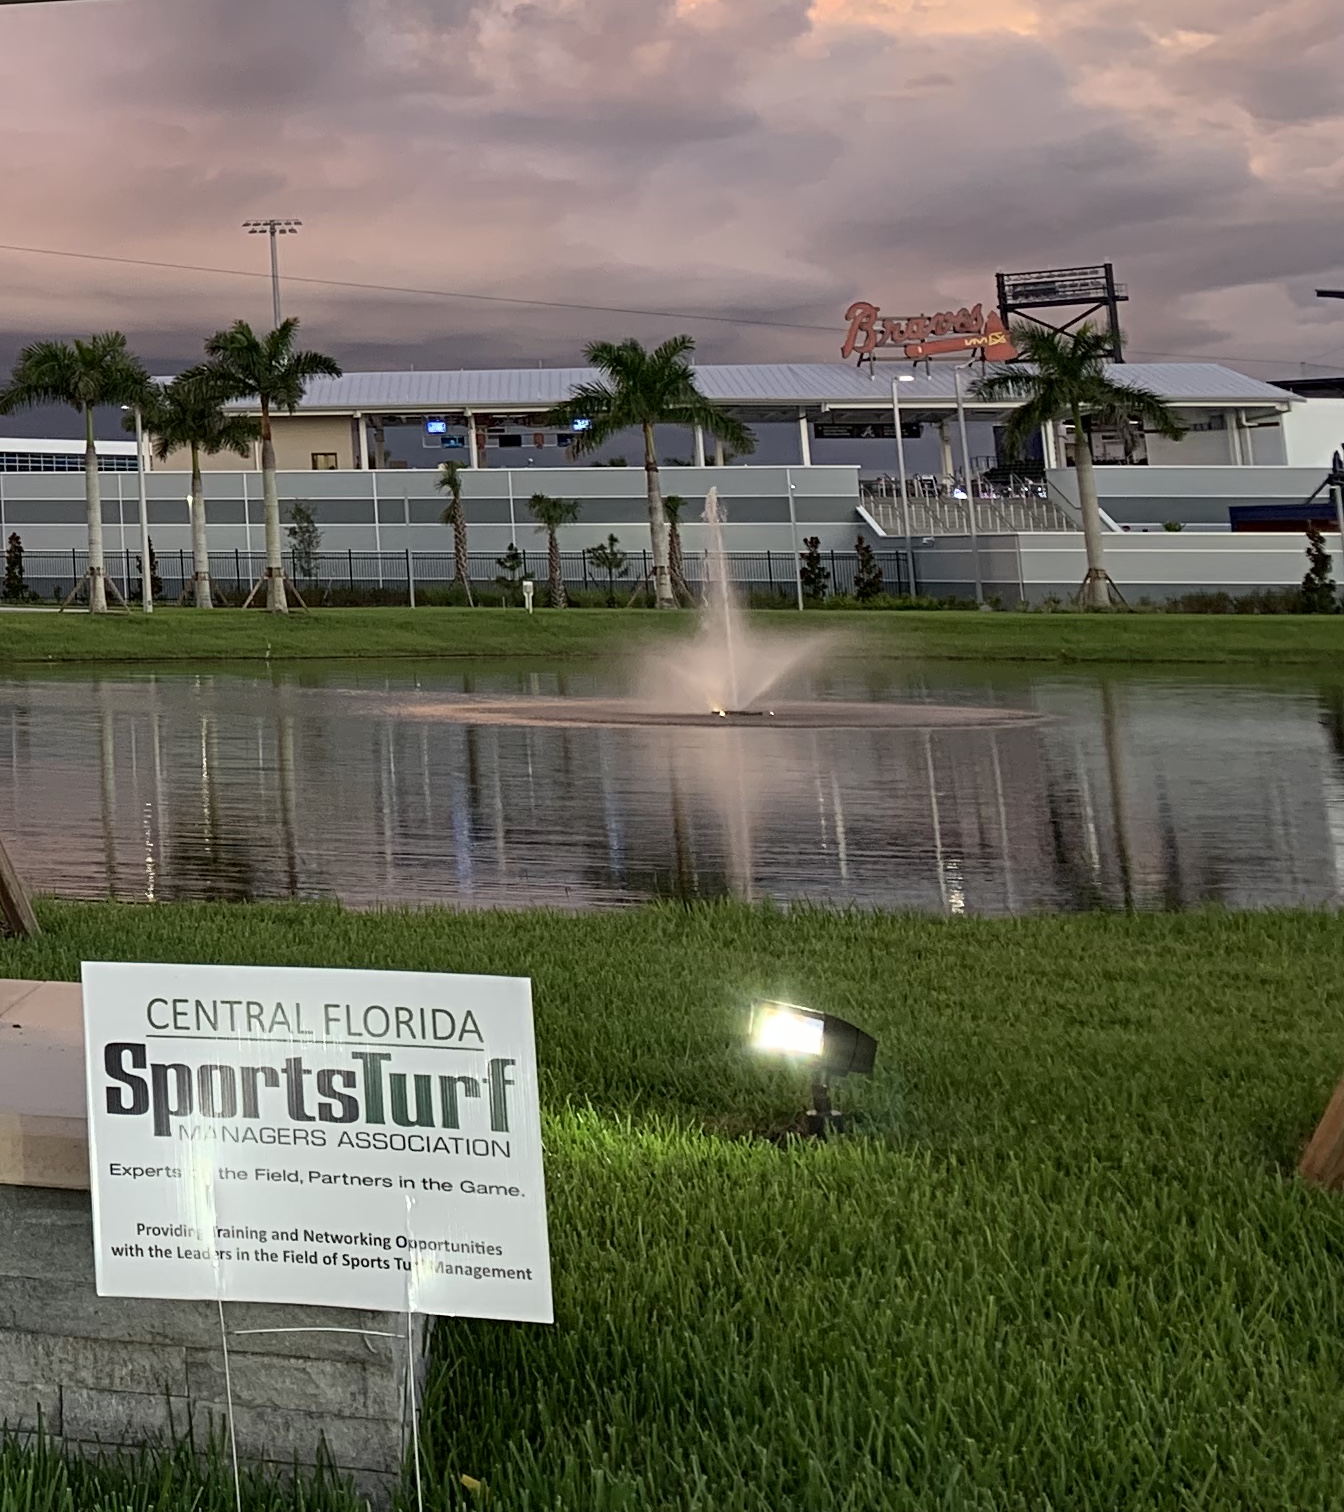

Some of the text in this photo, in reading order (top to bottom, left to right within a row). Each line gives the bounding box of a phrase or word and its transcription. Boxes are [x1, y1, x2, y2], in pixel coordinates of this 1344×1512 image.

[146, 997, 485, 1043] CENTRAL FLORIDA
[104, 1042, 516, 1137] SportsTurf
[178, 1123, 511, 1158] MANAGERS ASSOCIATION
[109, 1163, 182, 1180] Experts
[218, 1167, 248, 1180] the
[255, 1168, 304, 1184] Field,
[308, 1170, 393, 1188] Partners
[399, 1175, 415, 1189] in
[422, 1177, 453, 1192] the
[460, 1180, 526, 1197] Game.
[111, 1243, 144, 1258] with
[148, 1244, 173, 1259] the
[236, 1247, 250, 1262] in
[254, 1248, 278, 1263] the
[283, 1250, 318, 1265] Field
[322, 1251, 338, 1266] of
[342, 1253, 390, 1271] Sports
[271, 1228, 299, 1242] and
[303, 1229, 391, 1250] Networking
[395, 1234, 503, 1257] Opportunities
